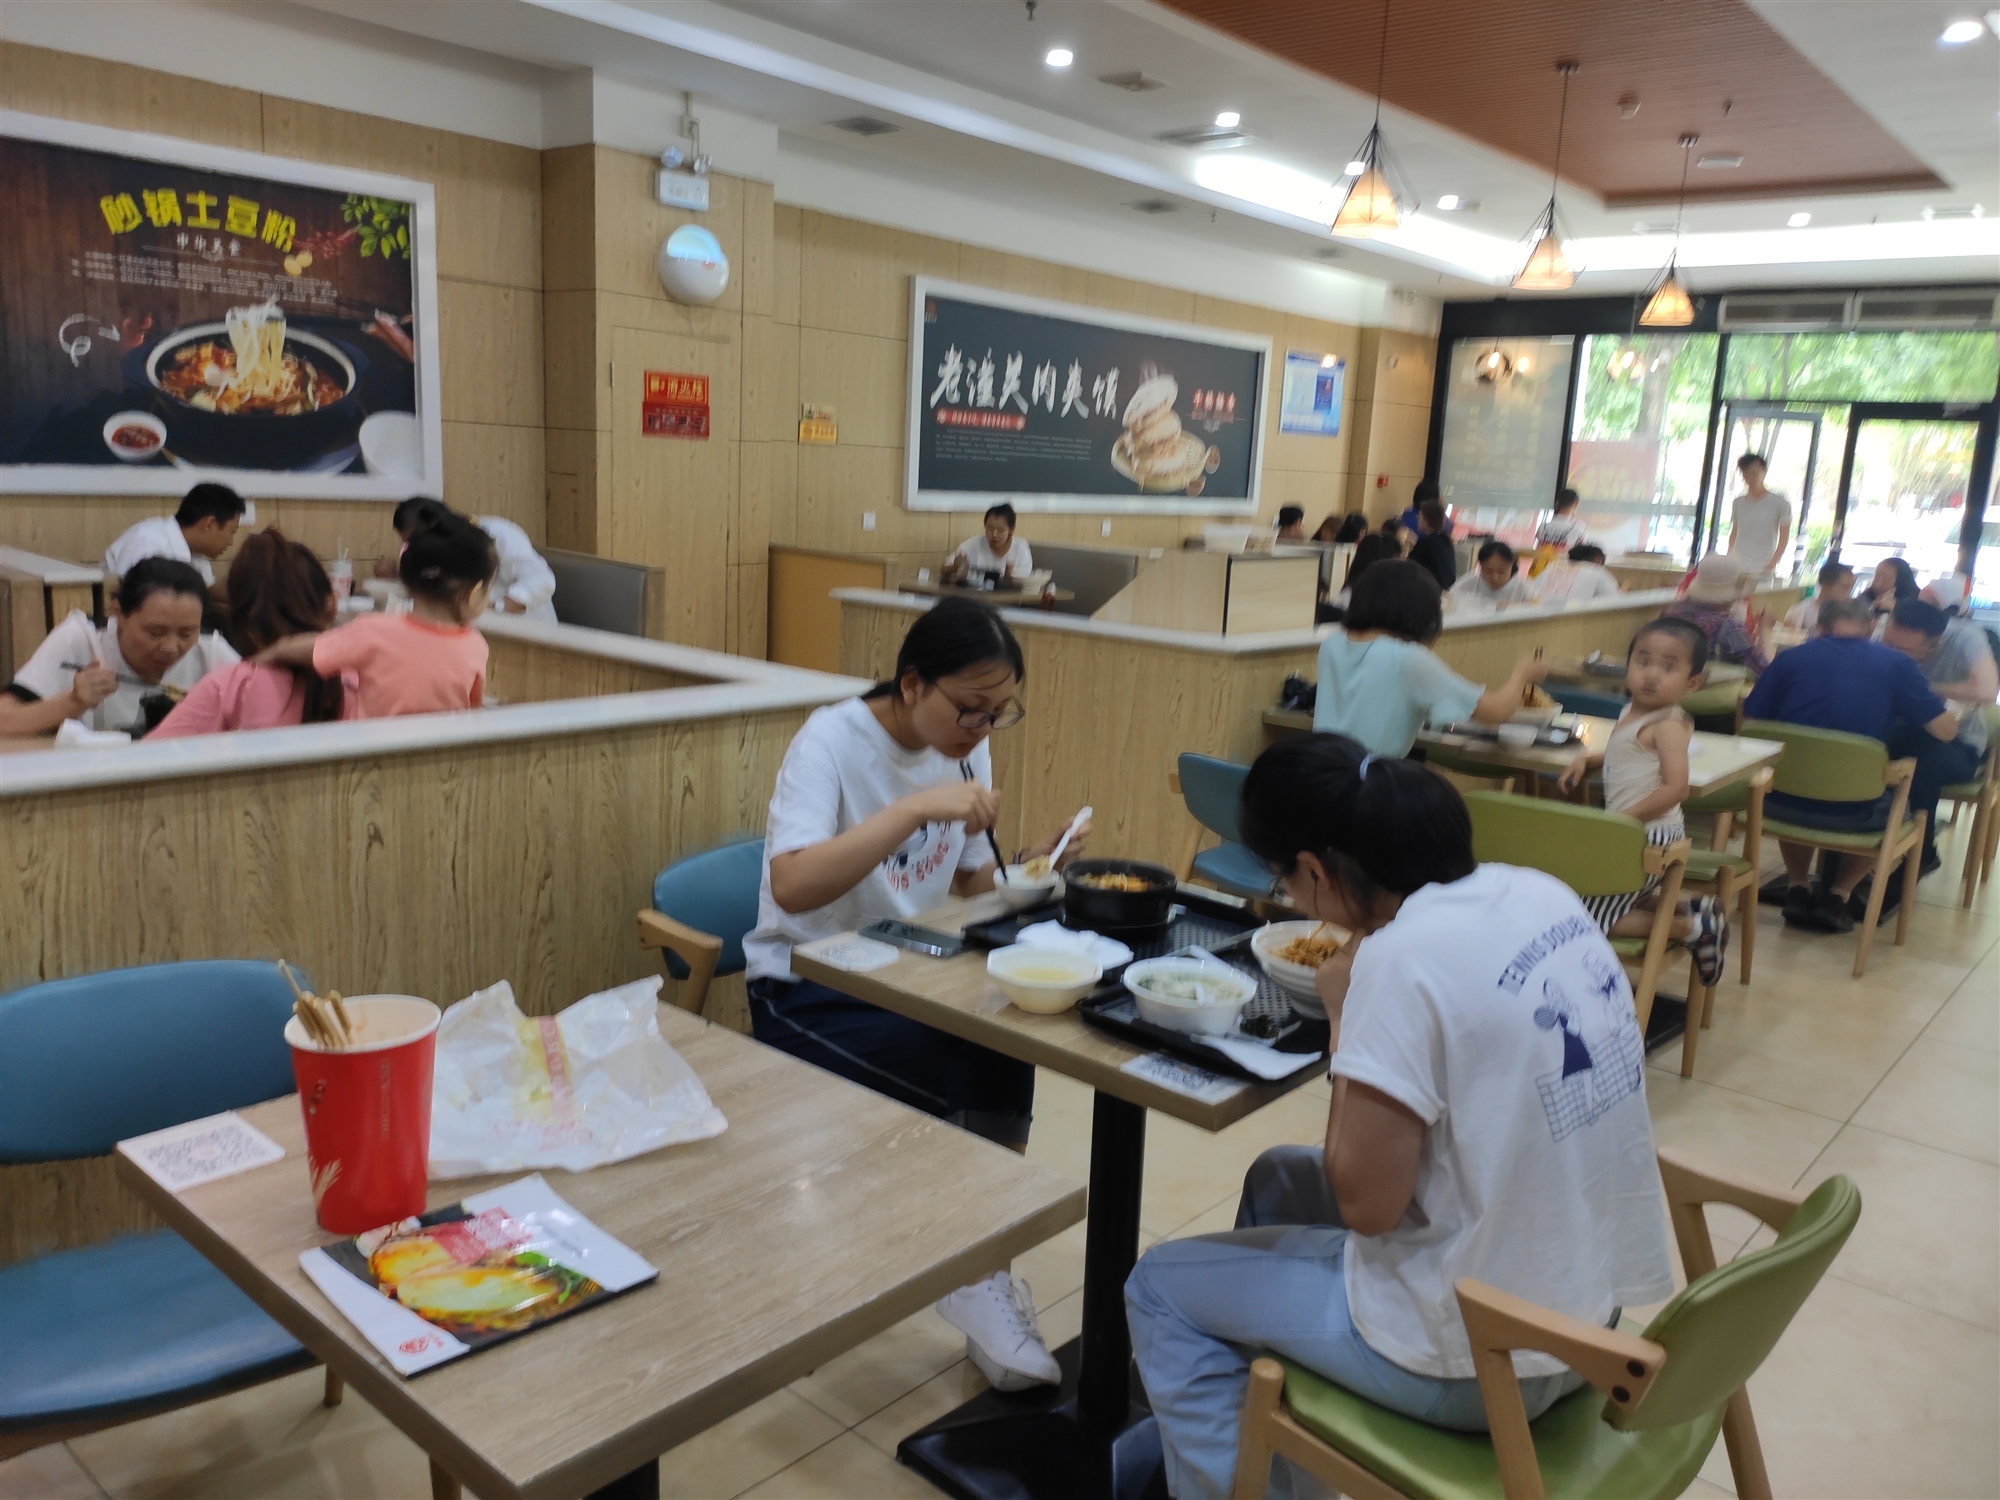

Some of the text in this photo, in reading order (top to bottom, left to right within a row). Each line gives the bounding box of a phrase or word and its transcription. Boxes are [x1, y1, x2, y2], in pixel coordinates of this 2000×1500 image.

[100, 187, 296, 253] 砂锅土豆粉
